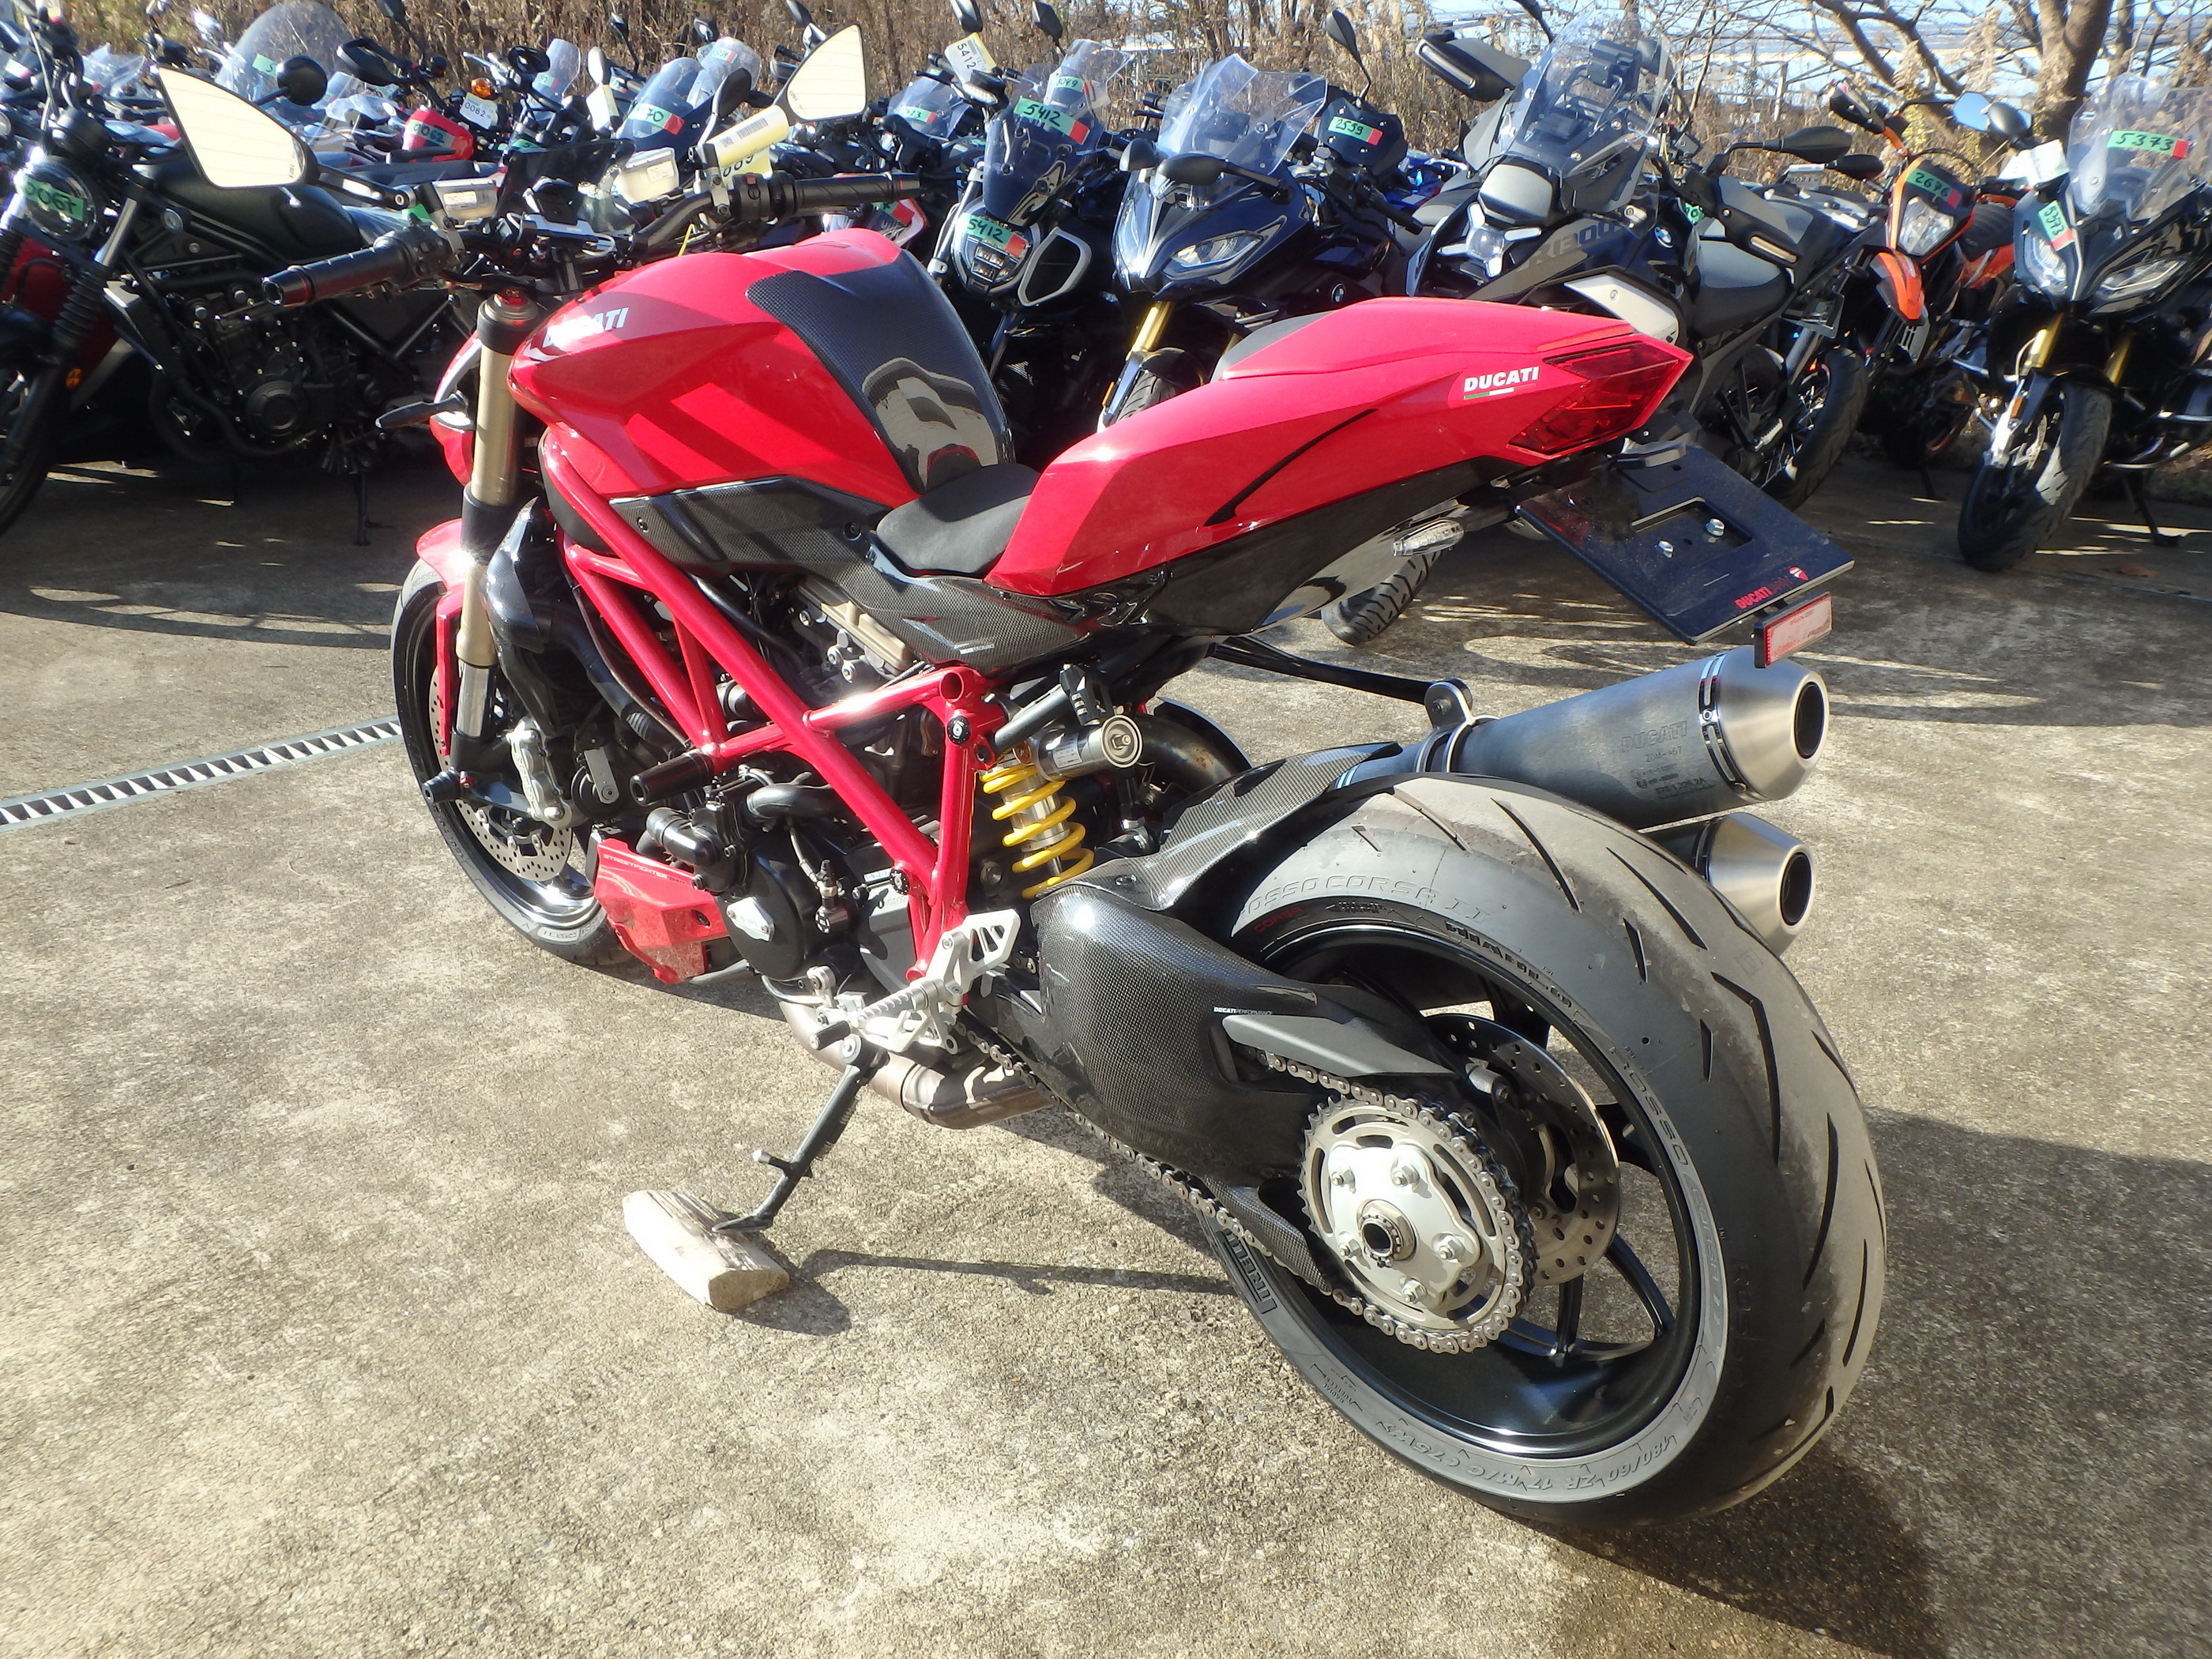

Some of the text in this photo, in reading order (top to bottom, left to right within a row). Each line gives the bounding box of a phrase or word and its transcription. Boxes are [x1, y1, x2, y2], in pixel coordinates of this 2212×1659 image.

[957, 43, 976, 70] 5412
[465, 102, 487, 118] 0062
[1023, 103, 1061, 127] 5412
[1335, 118, 1364, 136] 2559
[2115, 133, 2172, 151] 5373
[966, 218, 1004, 243] 5412
[2043, 207, 2065, 236] 5373
[1463, 366, 1540, 393] DUCATI
[1733, 586, 1773, 609] DUCATI
[1622, 720, 1688, 753] DUCATI
[1325, 875, 1441, 905] CORSA
[1254, 907, 1304, 933] CORSA
[1527, 1476, 1555, 1491] 17
